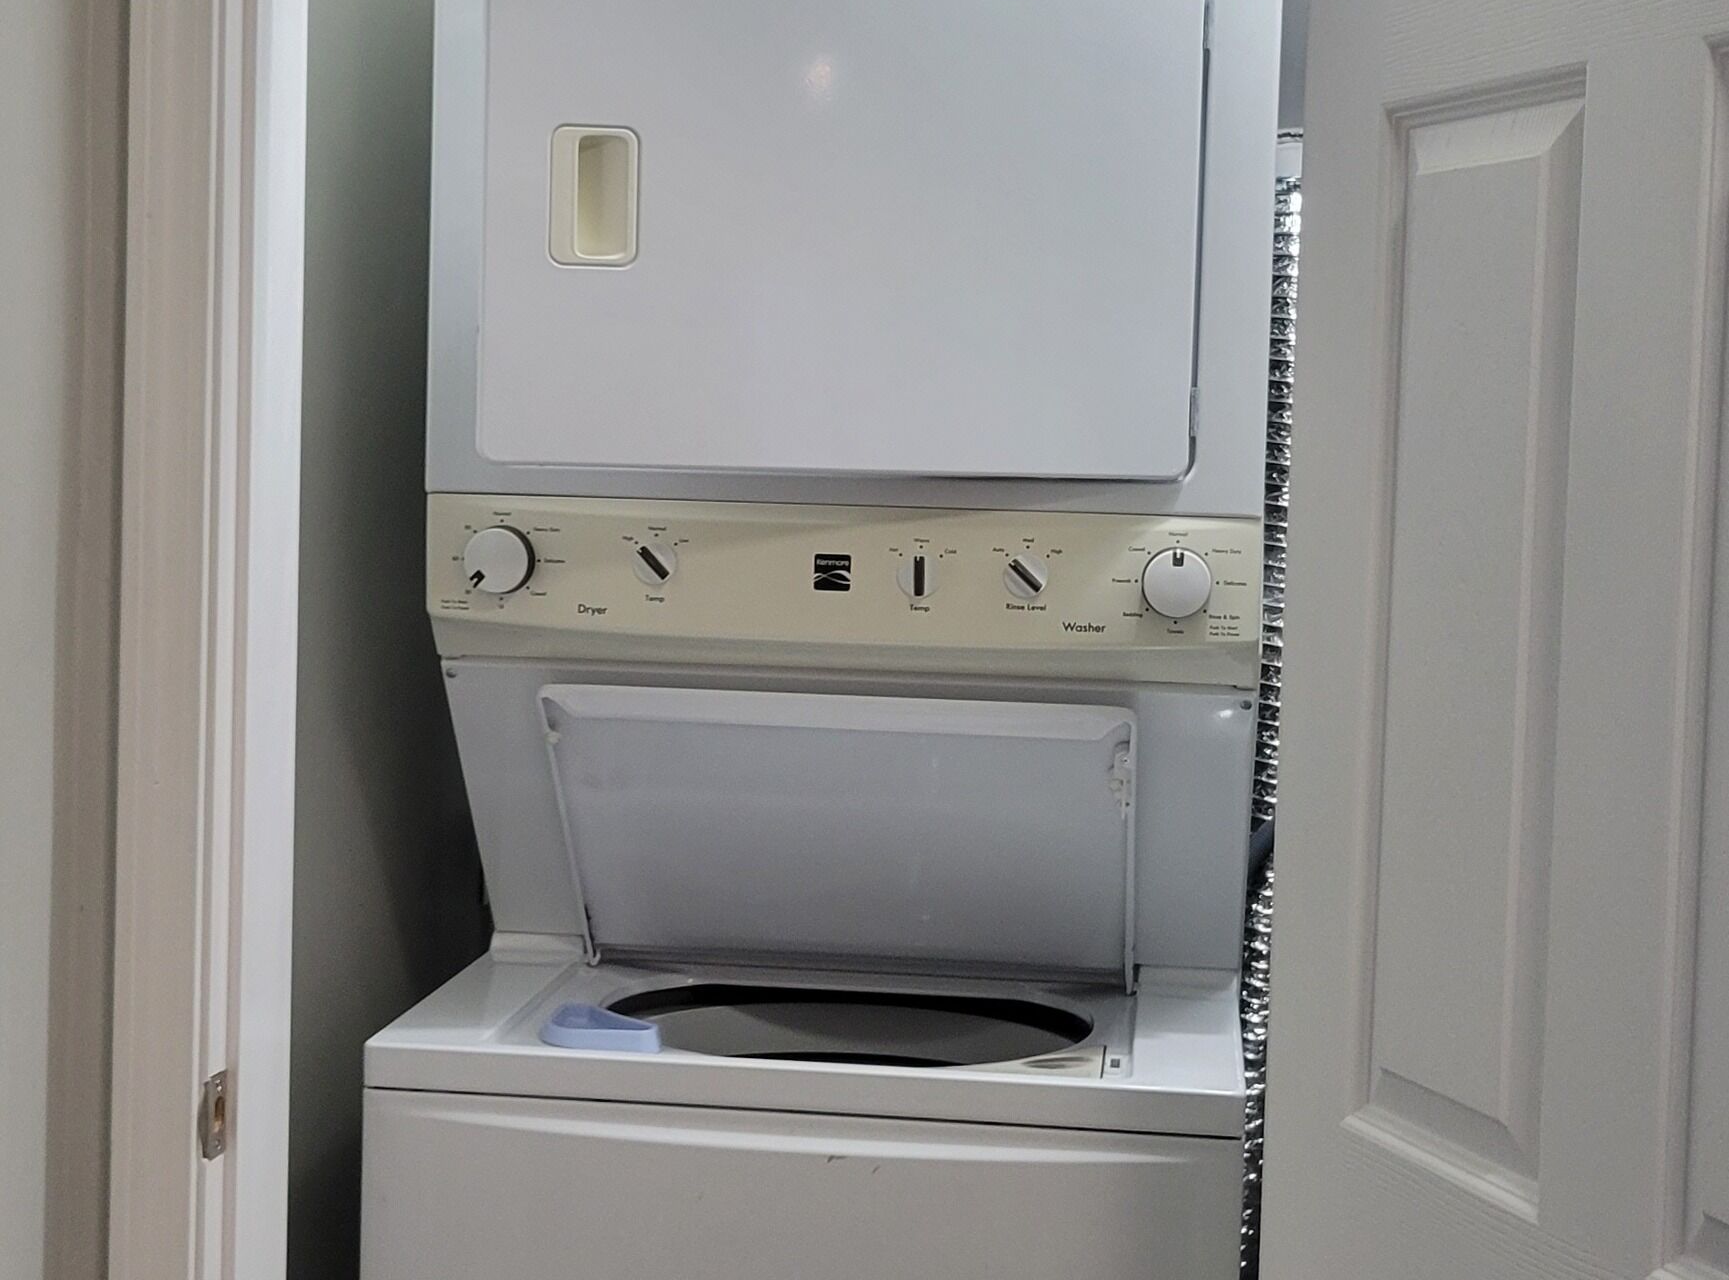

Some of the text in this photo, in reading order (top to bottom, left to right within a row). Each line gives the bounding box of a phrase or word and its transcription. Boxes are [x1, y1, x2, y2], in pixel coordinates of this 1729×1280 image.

[577, 603, 608, 616] Dryer
[909, 604, 930, 613] Temp
[1027, 603, 1047, 612] Level
[1062, 621, 1107, 633] Washer
